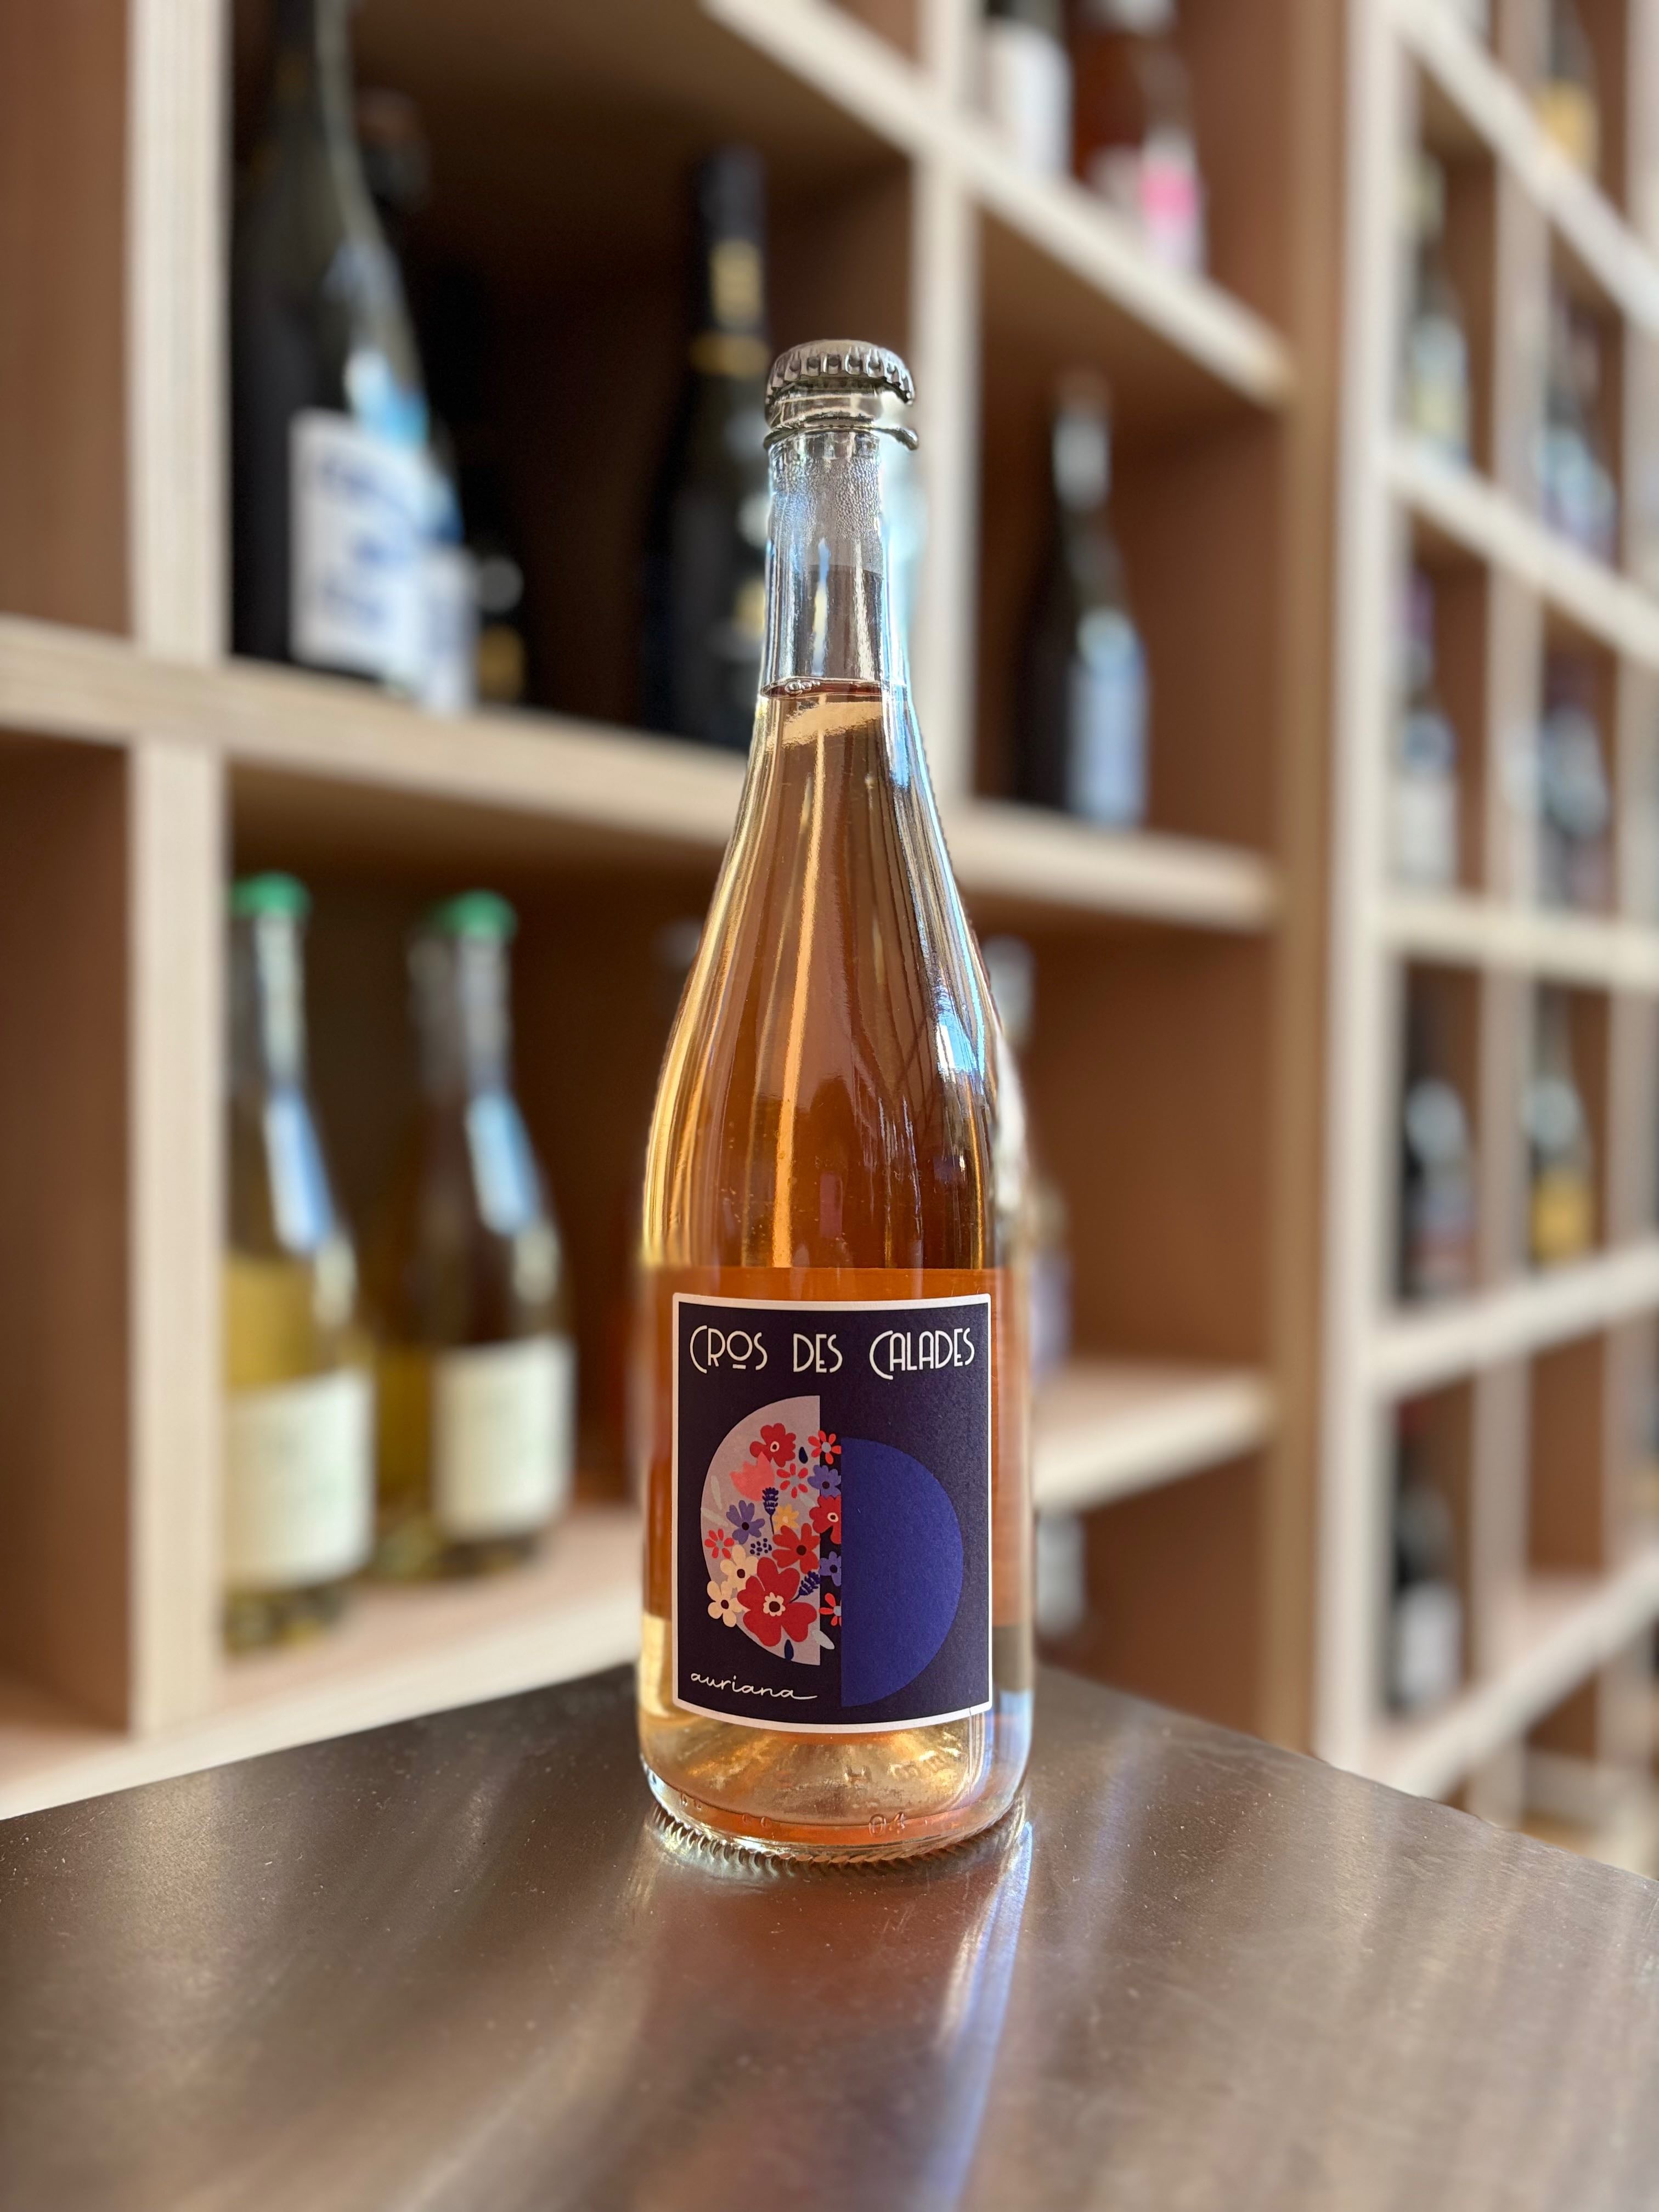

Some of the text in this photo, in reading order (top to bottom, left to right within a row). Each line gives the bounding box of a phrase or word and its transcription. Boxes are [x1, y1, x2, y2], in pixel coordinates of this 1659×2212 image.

[690, 1325, 974, 1380] CROS DES CALADES
[691, 1673, 817, 1699] auriana
